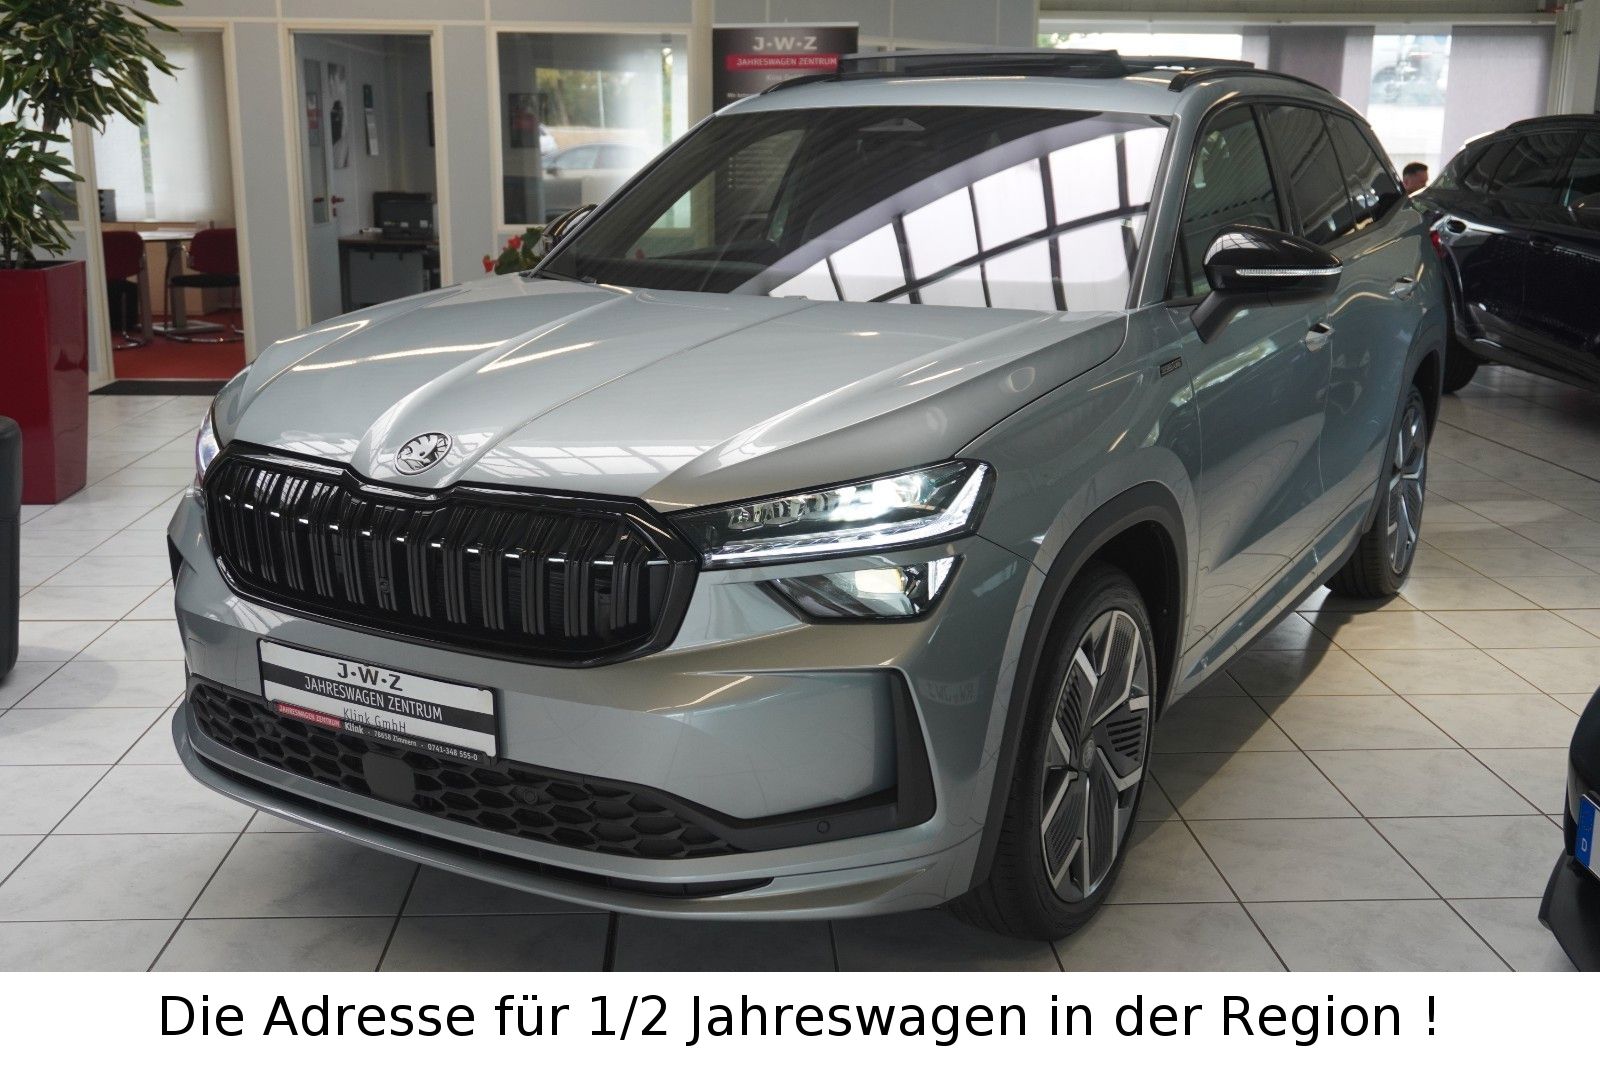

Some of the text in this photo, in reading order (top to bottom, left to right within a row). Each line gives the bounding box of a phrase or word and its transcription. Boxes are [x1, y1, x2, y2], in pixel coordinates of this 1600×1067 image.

[736, 57, 838, 66] JAHRESWAGEN ZENTRUM
[304, 675, 443, 721] JAHRESWAGEN ZENTRUM
[279, 704, 315, 721] JAHRESWAGEN
[343, 707, 406, 733] Klink GmbH
[344, 721, 364, 735] Klink
[1581, 837, 1588, 853] D
